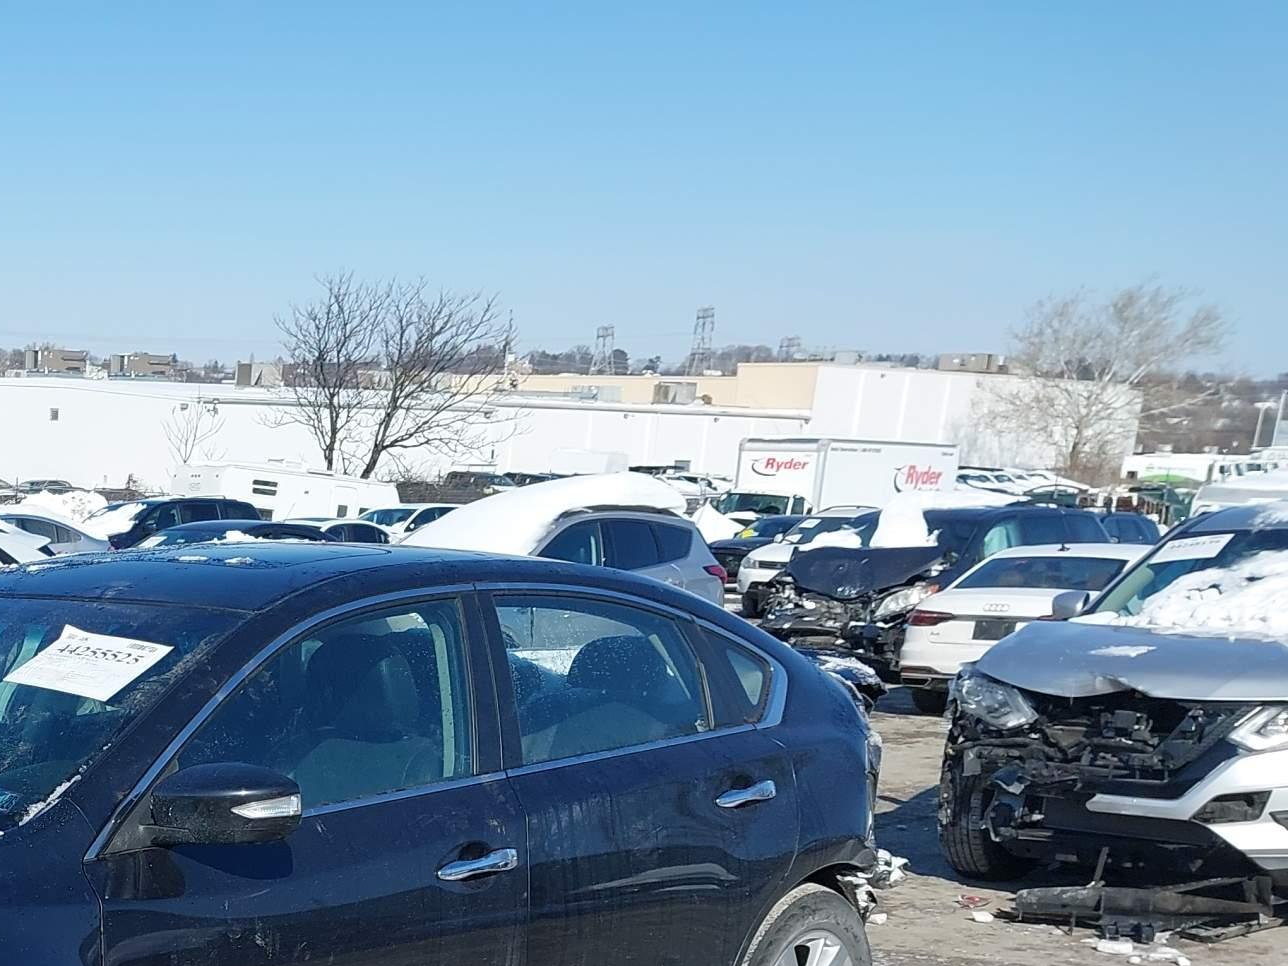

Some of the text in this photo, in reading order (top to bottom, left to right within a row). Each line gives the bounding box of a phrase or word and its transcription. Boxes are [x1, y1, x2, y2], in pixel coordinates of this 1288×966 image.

[764, 457, 809, 472] Ryder
[904, 465, 943, 489] Ryder
[57, 643, 145, 665] 44255525
